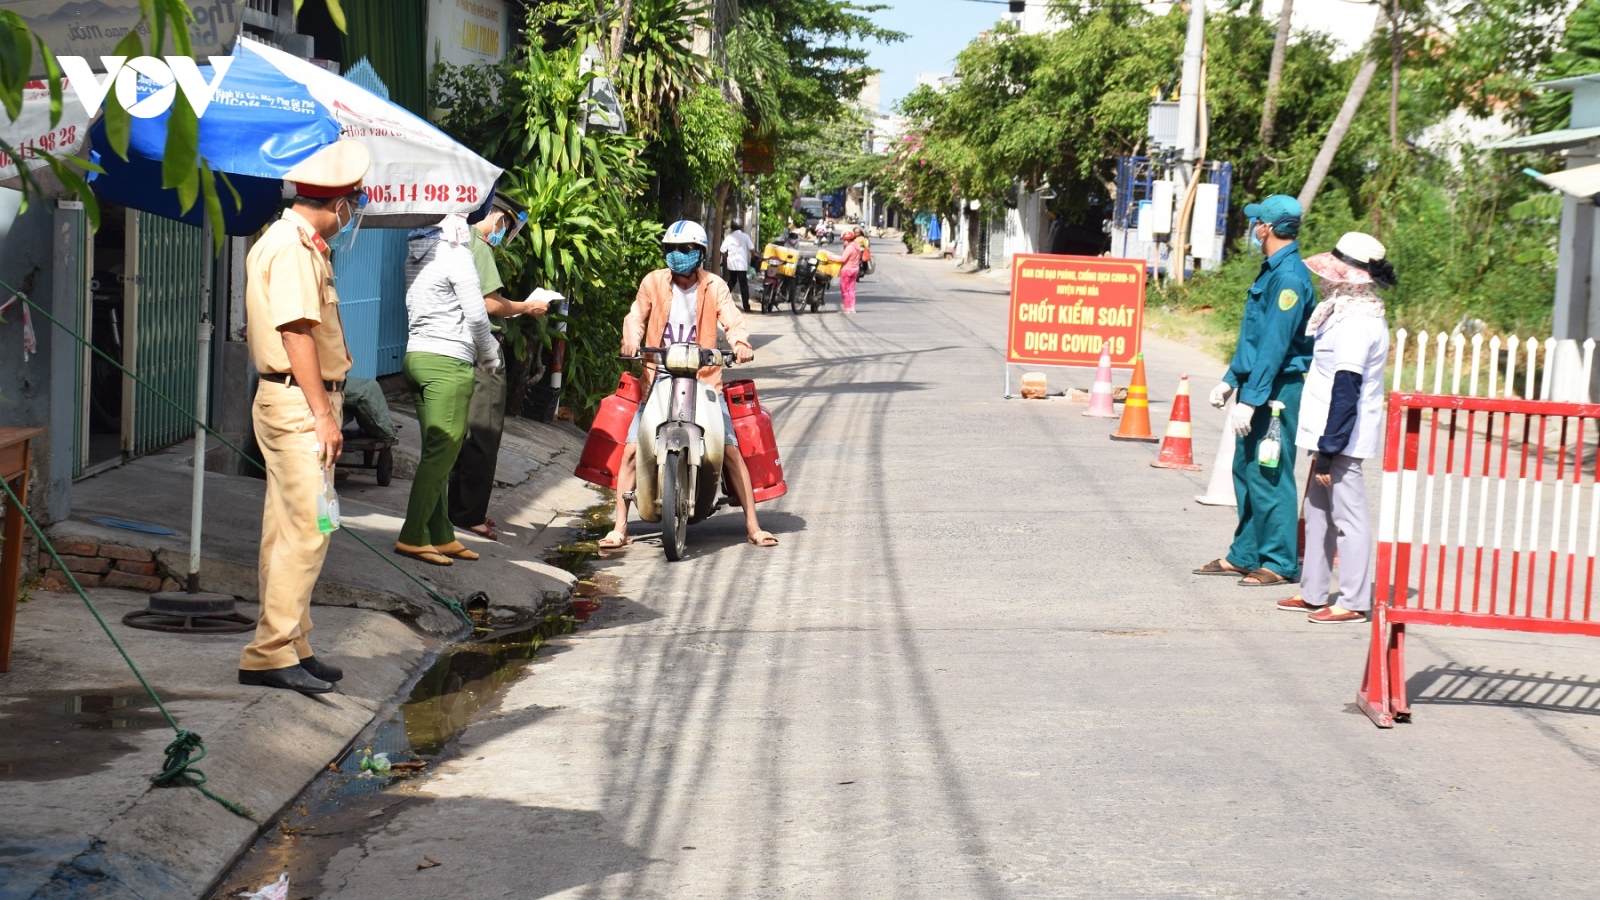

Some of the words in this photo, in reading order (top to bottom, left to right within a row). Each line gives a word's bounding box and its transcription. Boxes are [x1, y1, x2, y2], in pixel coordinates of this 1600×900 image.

[39, 132, 56, 153] 98
[59, 125, 77, 148] 28
[424, 183, 450, 203] 98
[455, 184, 478, 203] 28
[1022, 268, 1034, 278] BAN
[1097, 272, 1110, 284] DỊCH
[1111, 273, 1136, 284] COVID-19
[1018, 298, 1056, 323] CHỐT
[1058, 299, 1094, 325] KIỂM
[1098, 304, 1135, 327] SOÁT
[1024, 331, 1058, 355] DỊCH
[1061, 333, 1126, 355] COVID-19
